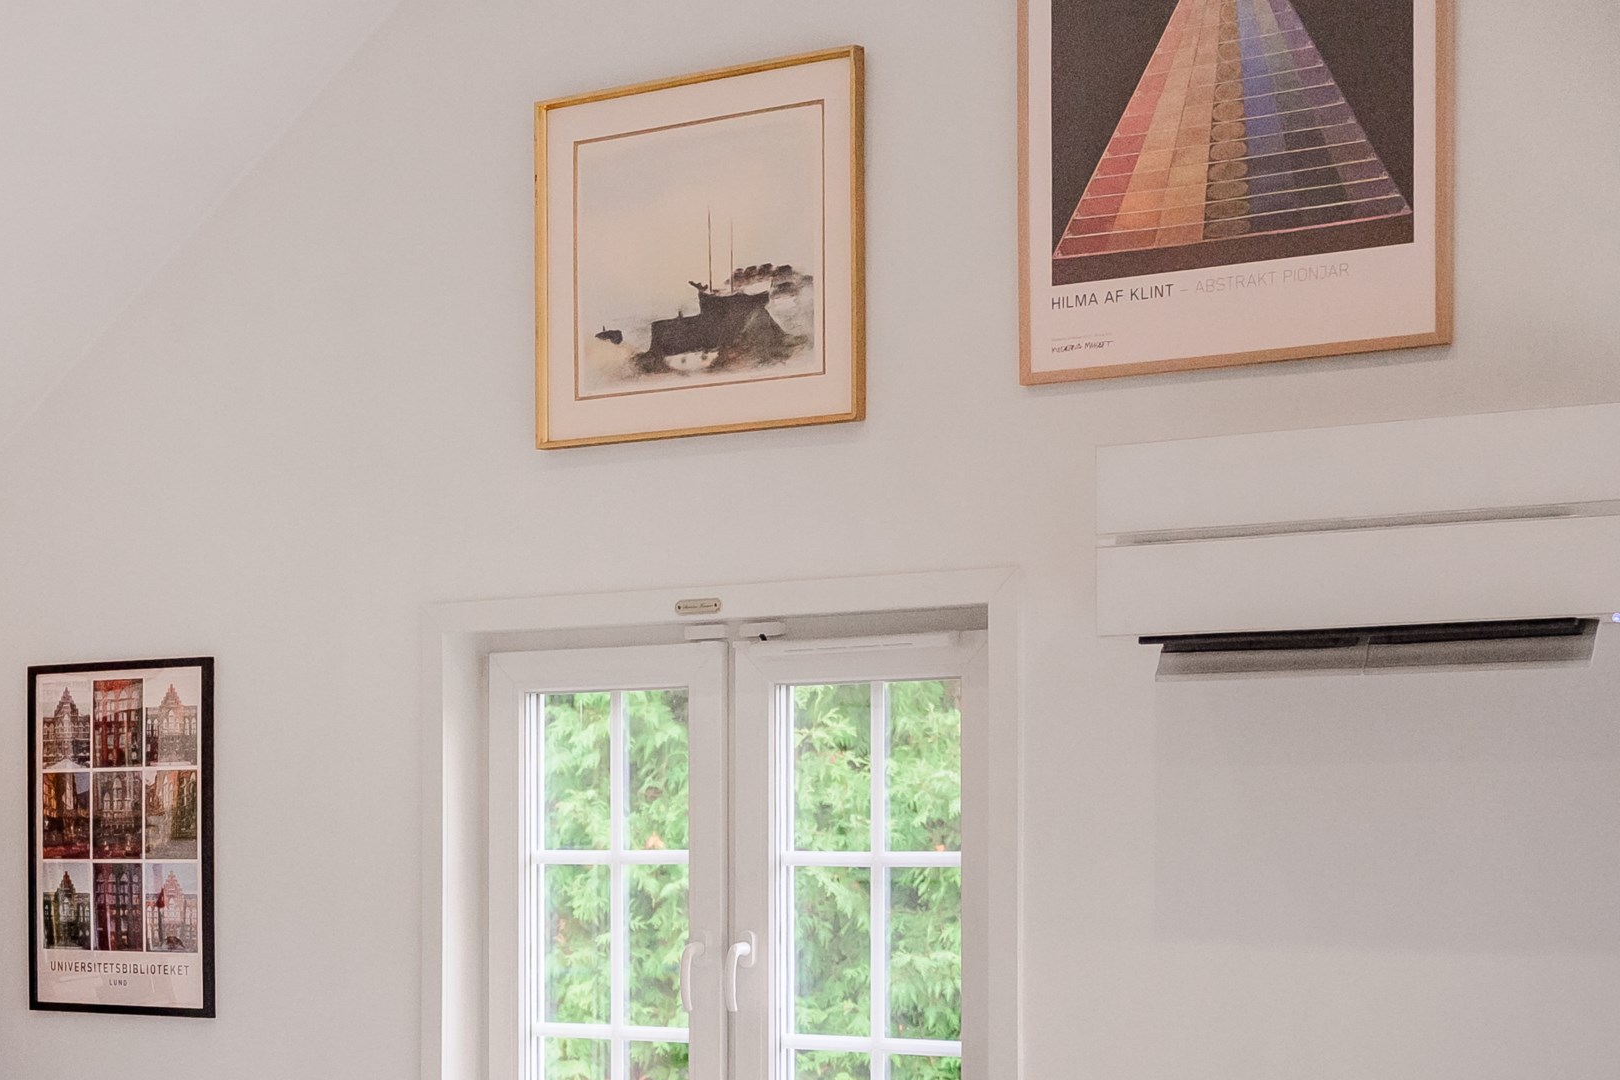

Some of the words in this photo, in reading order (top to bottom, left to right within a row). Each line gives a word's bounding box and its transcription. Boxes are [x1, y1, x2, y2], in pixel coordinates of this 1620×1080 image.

[1051, 292, 1098, 310] HILMA
[1104, 290, 1124, 304] AF
[1130, 284, 1174, 301] KLINT
[1195, 271, 1276, 293] ABSTRAKT
[50, 960, 189, 975] UNIVERSITETSBIBLIOTEKET
